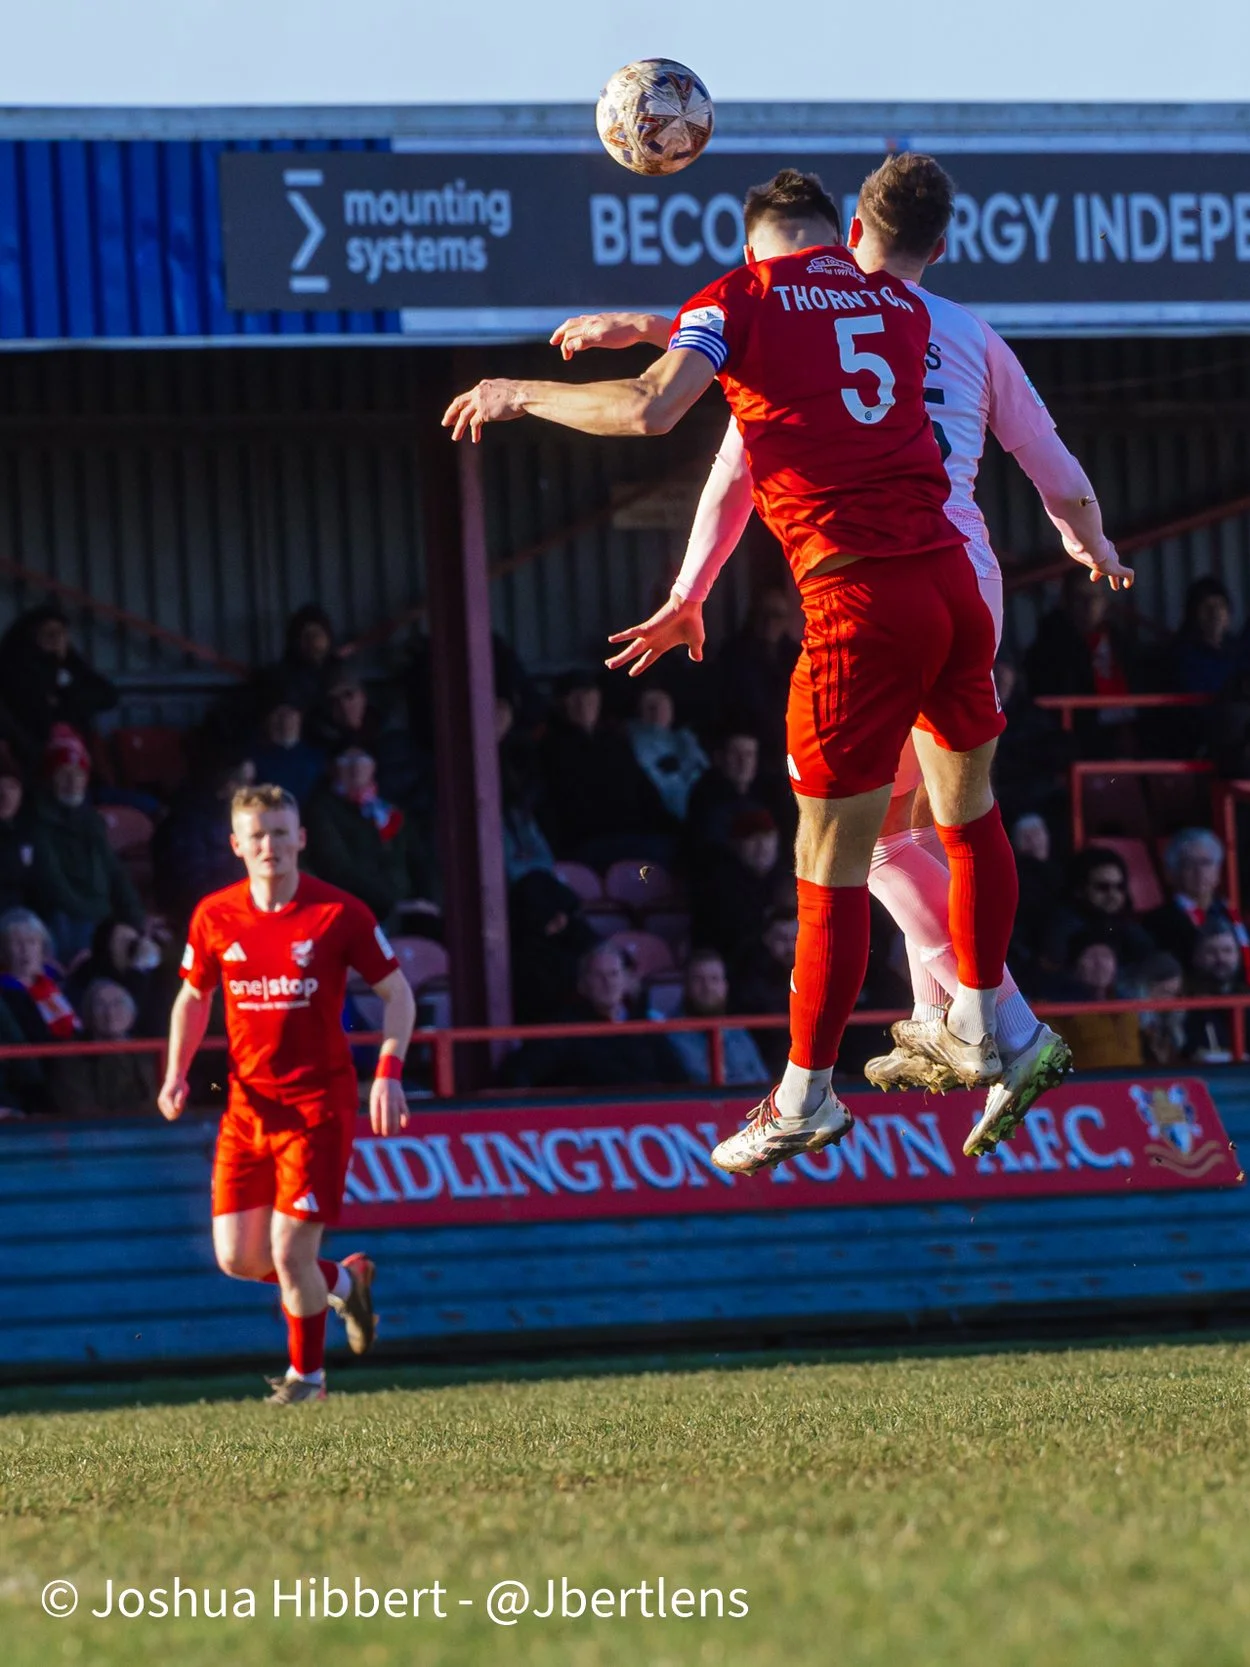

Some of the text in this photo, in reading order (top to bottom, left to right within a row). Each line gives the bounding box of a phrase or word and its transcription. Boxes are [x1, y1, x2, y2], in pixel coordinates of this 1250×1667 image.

[343, 178, 512, 237] mounting
[590, 192, 746, 266] BECO
[346, 230, 488, 284] systems
[833, 314, 896, 425] 5
